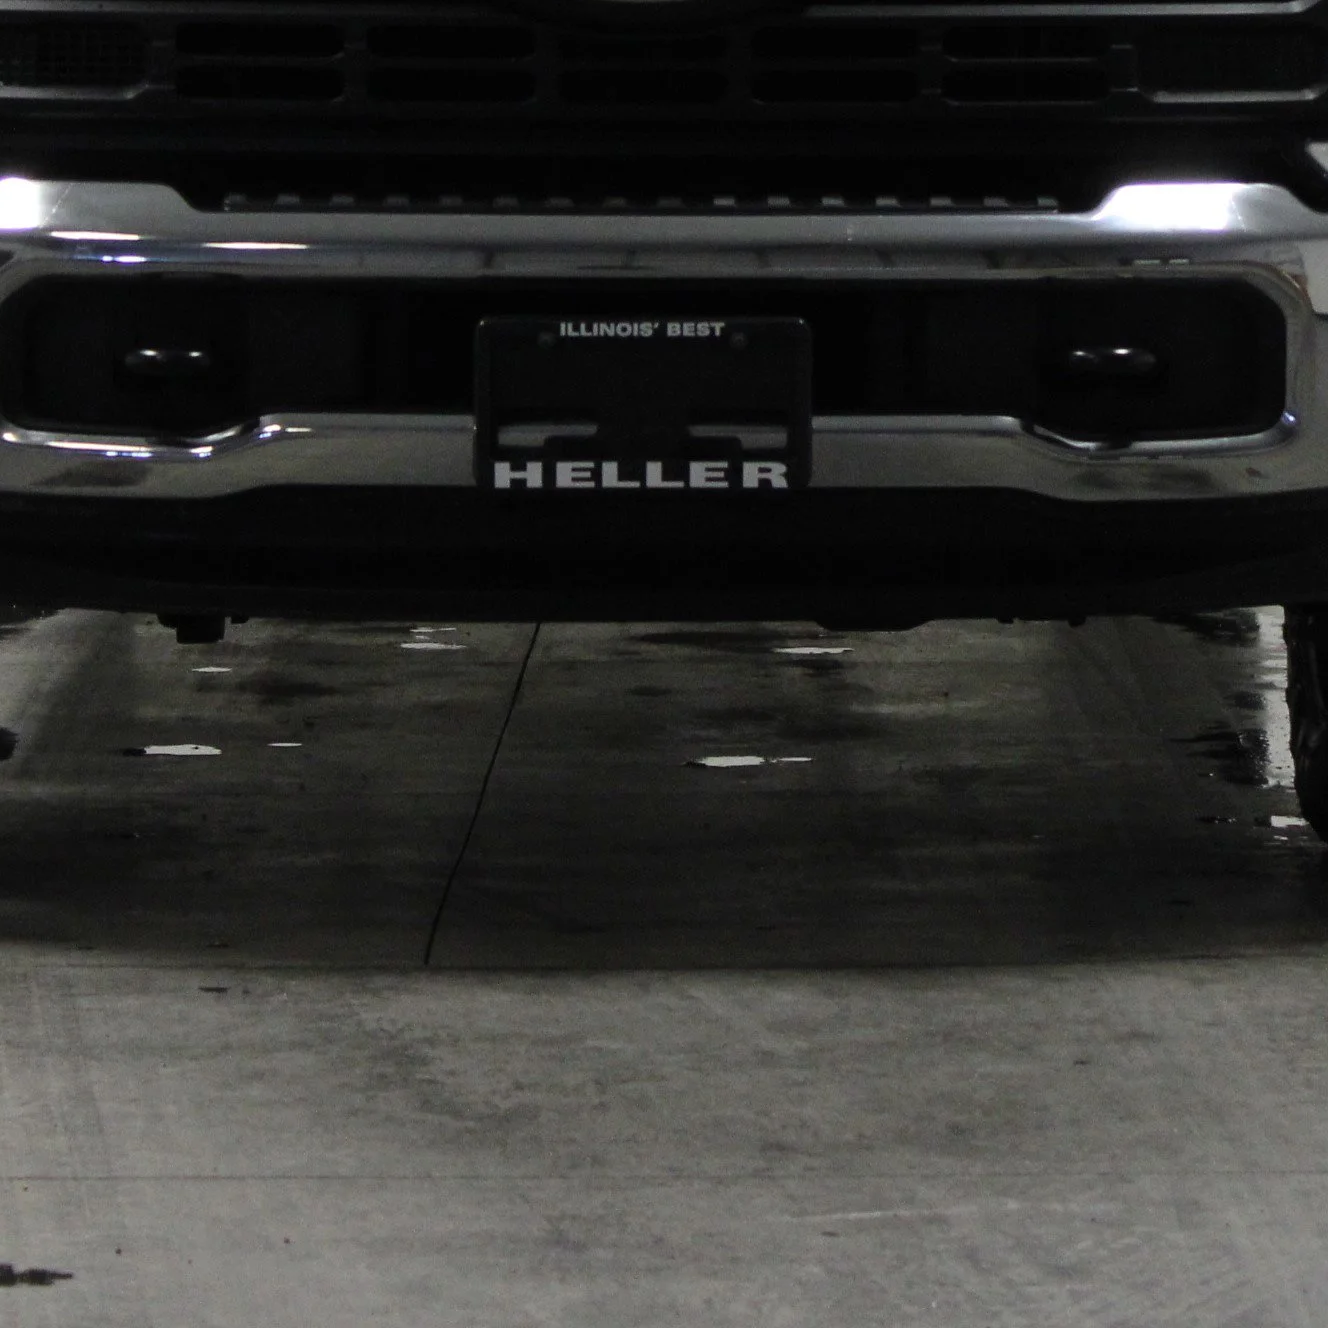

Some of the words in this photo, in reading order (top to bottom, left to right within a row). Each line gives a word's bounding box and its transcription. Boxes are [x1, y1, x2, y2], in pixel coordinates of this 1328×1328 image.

[559, 321, 660, 338] ILLINOIS'
[666, 321, 726, 338] BEST
[493, 460, 790, 490] HELLER
